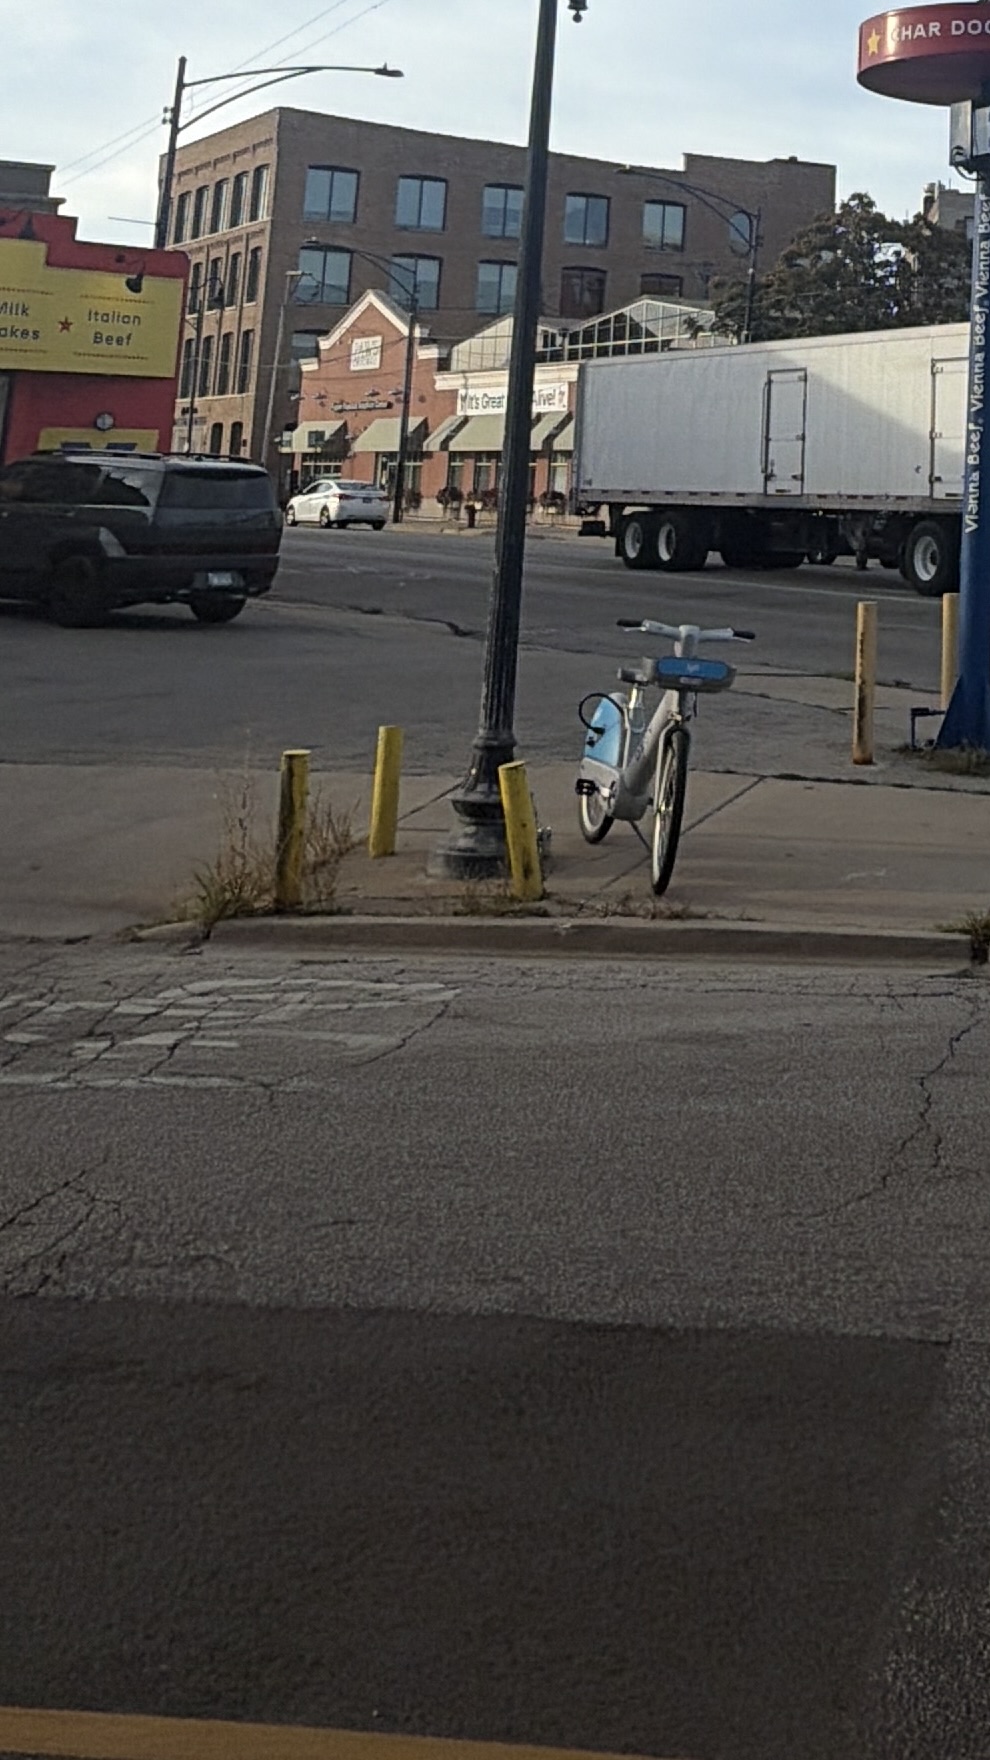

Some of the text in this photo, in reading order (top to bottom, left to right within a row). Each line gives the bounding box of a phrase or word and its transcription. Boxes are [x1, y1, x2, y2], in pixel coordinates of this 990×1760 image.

[891, 21, 941, 42] CHAR
[975, 239, 990, 298] Vienna
[87, 308, 142, 327] Italian
[0, 324, 40, 340] akes
[92, 331, 134, 346] Beef
[970, 351, 986, 412] Vienna
[481, 392, 505, 410] Great
